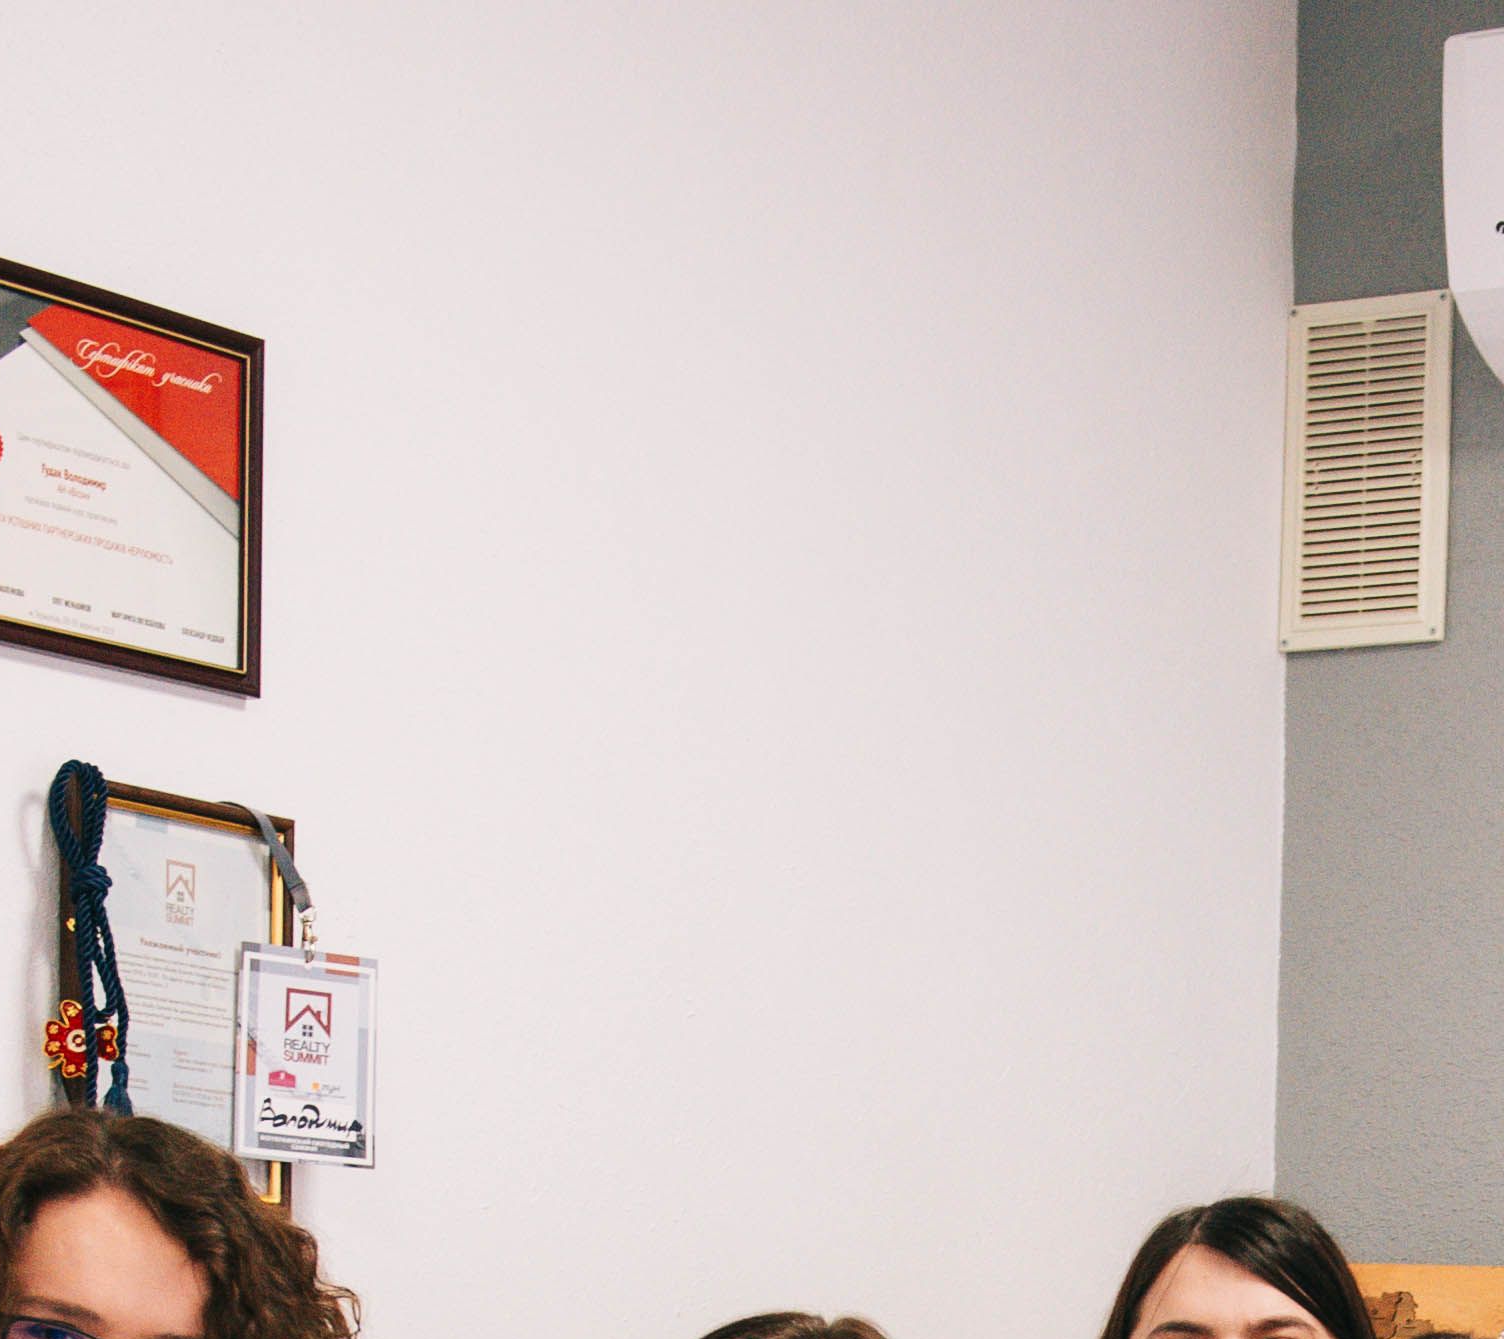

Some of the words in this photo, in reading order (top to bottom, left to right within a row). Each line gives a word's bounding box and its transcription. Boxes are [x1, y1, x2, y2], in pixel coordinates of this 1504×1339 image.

[71, 339, 155, 379] Сертифікат
[165, 901, 195, 917] REALTY
[283, 1038, 331, 1054] REALTY
[283, 1050, 329, 1066] SUMMIT
